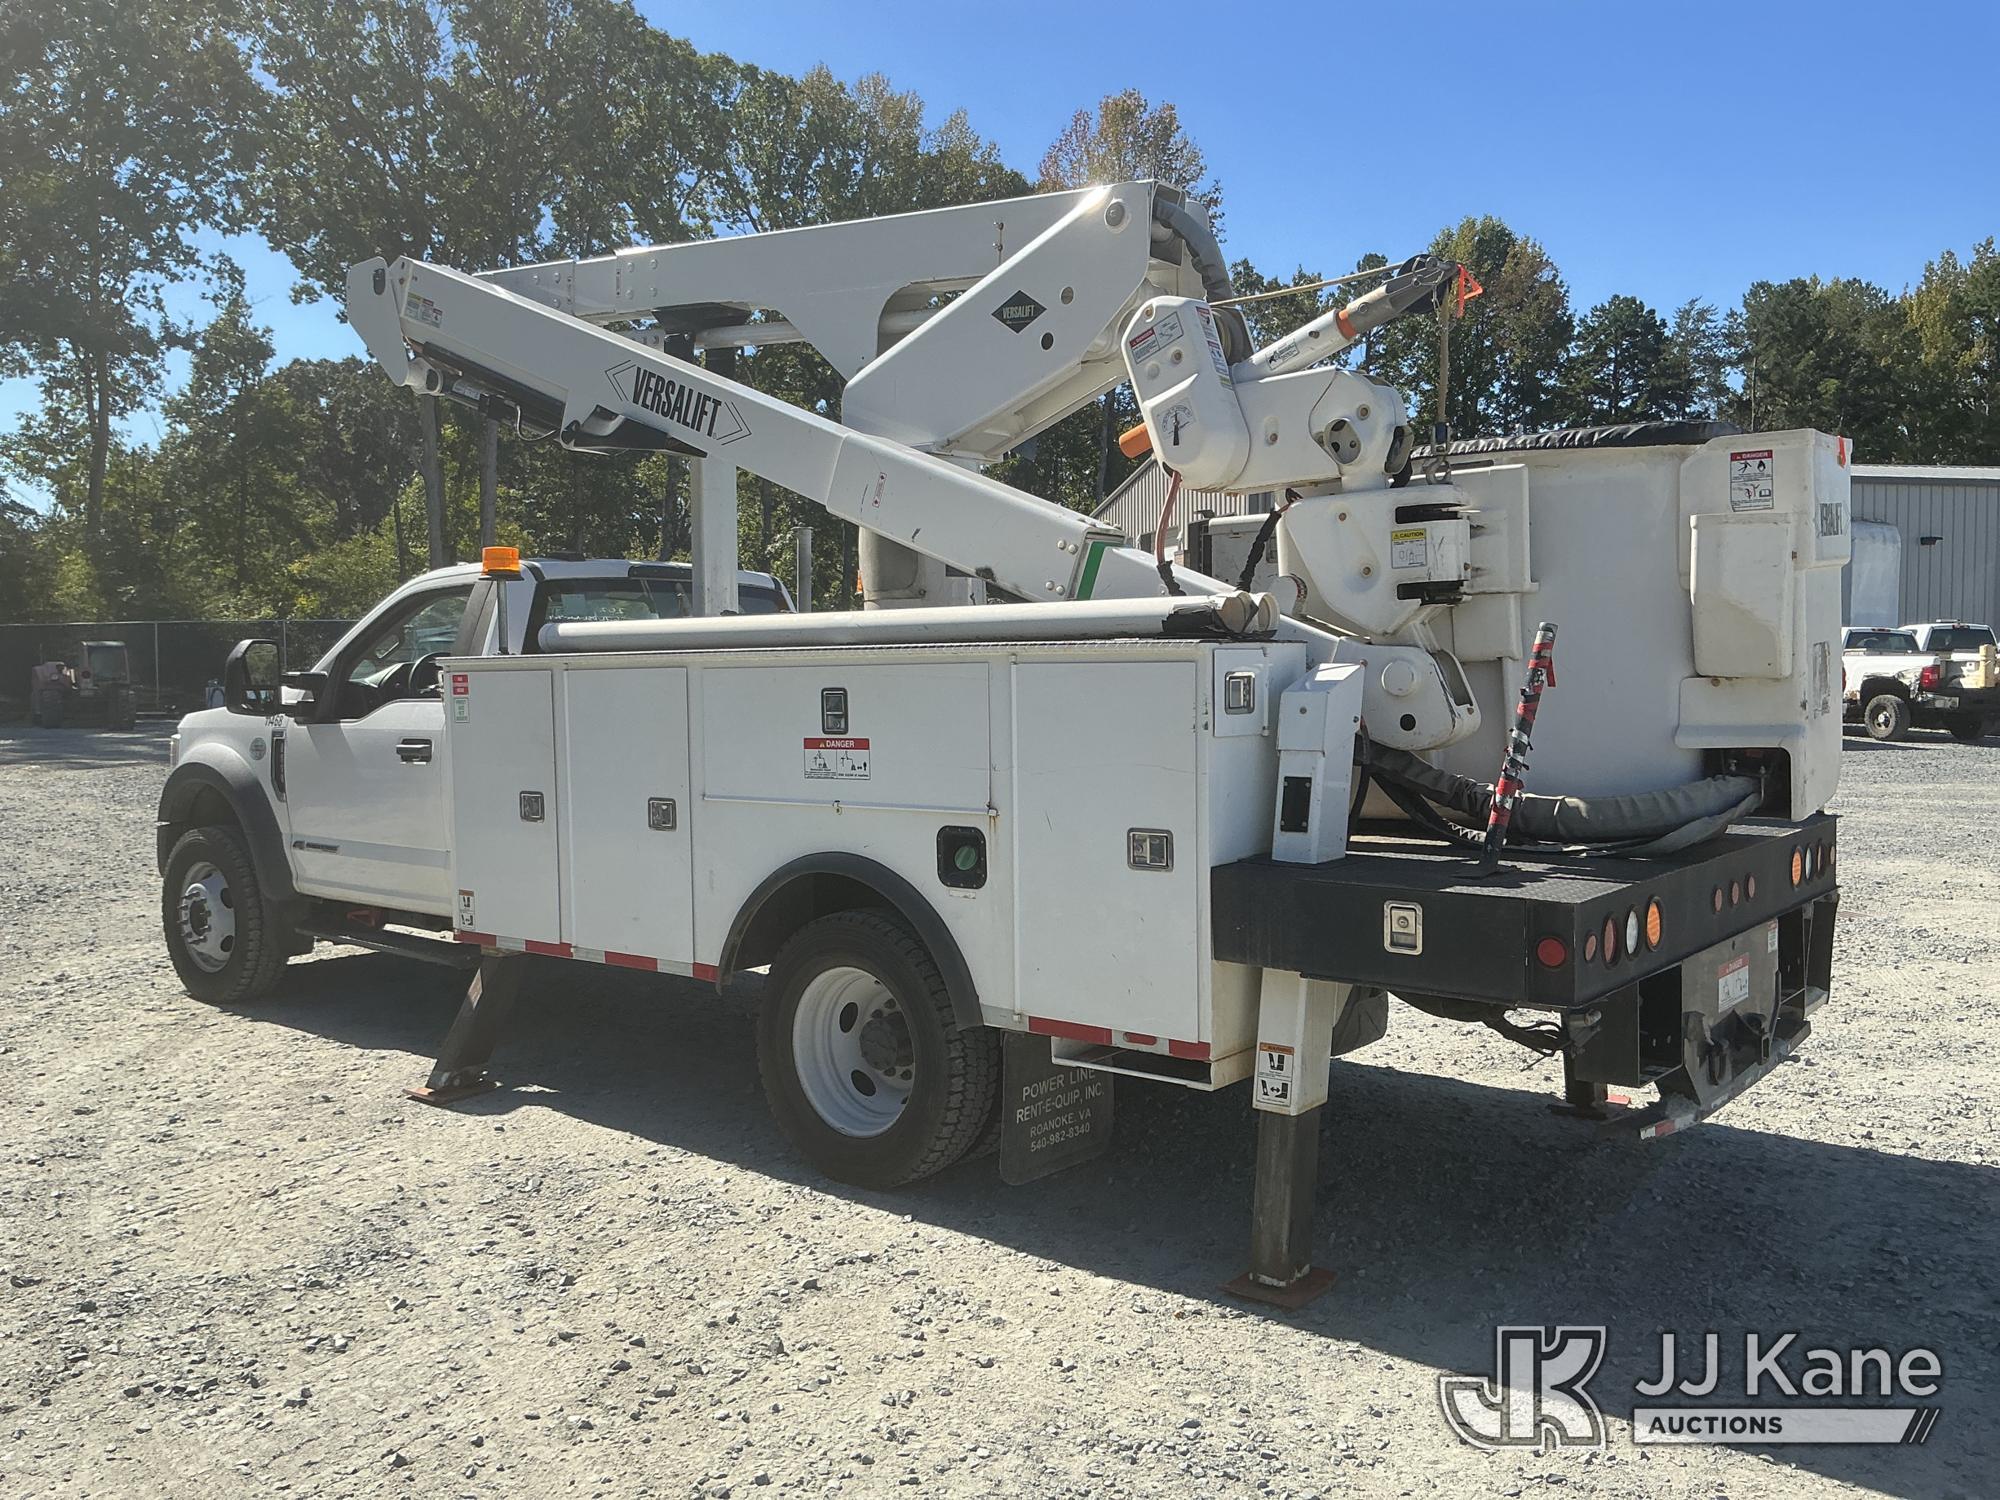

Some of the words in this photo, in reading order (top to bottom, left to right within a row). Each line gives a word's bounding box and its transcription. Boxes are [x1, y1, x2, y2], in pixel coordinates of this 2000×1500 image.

[1002, 304, 1035, 319] VERSALIFT
[632, 366, 722, 438] VERSALIFT
[1399, 531, 1424, 539] CAUTION
[825, 740, 855, 748] DANGER
[1022, 1073, 1065, 1102] POWER
[1070, 1067, 1096, 1084] LINE
[1016, 1089, 1083, 1124] RENT-E-QUIP,
[1085, 1082, 1105, 1100] INC.
[1079, 1108, 1092, 1120] VA
[1030, 1122, 1091, 1153] 540-982-8340
